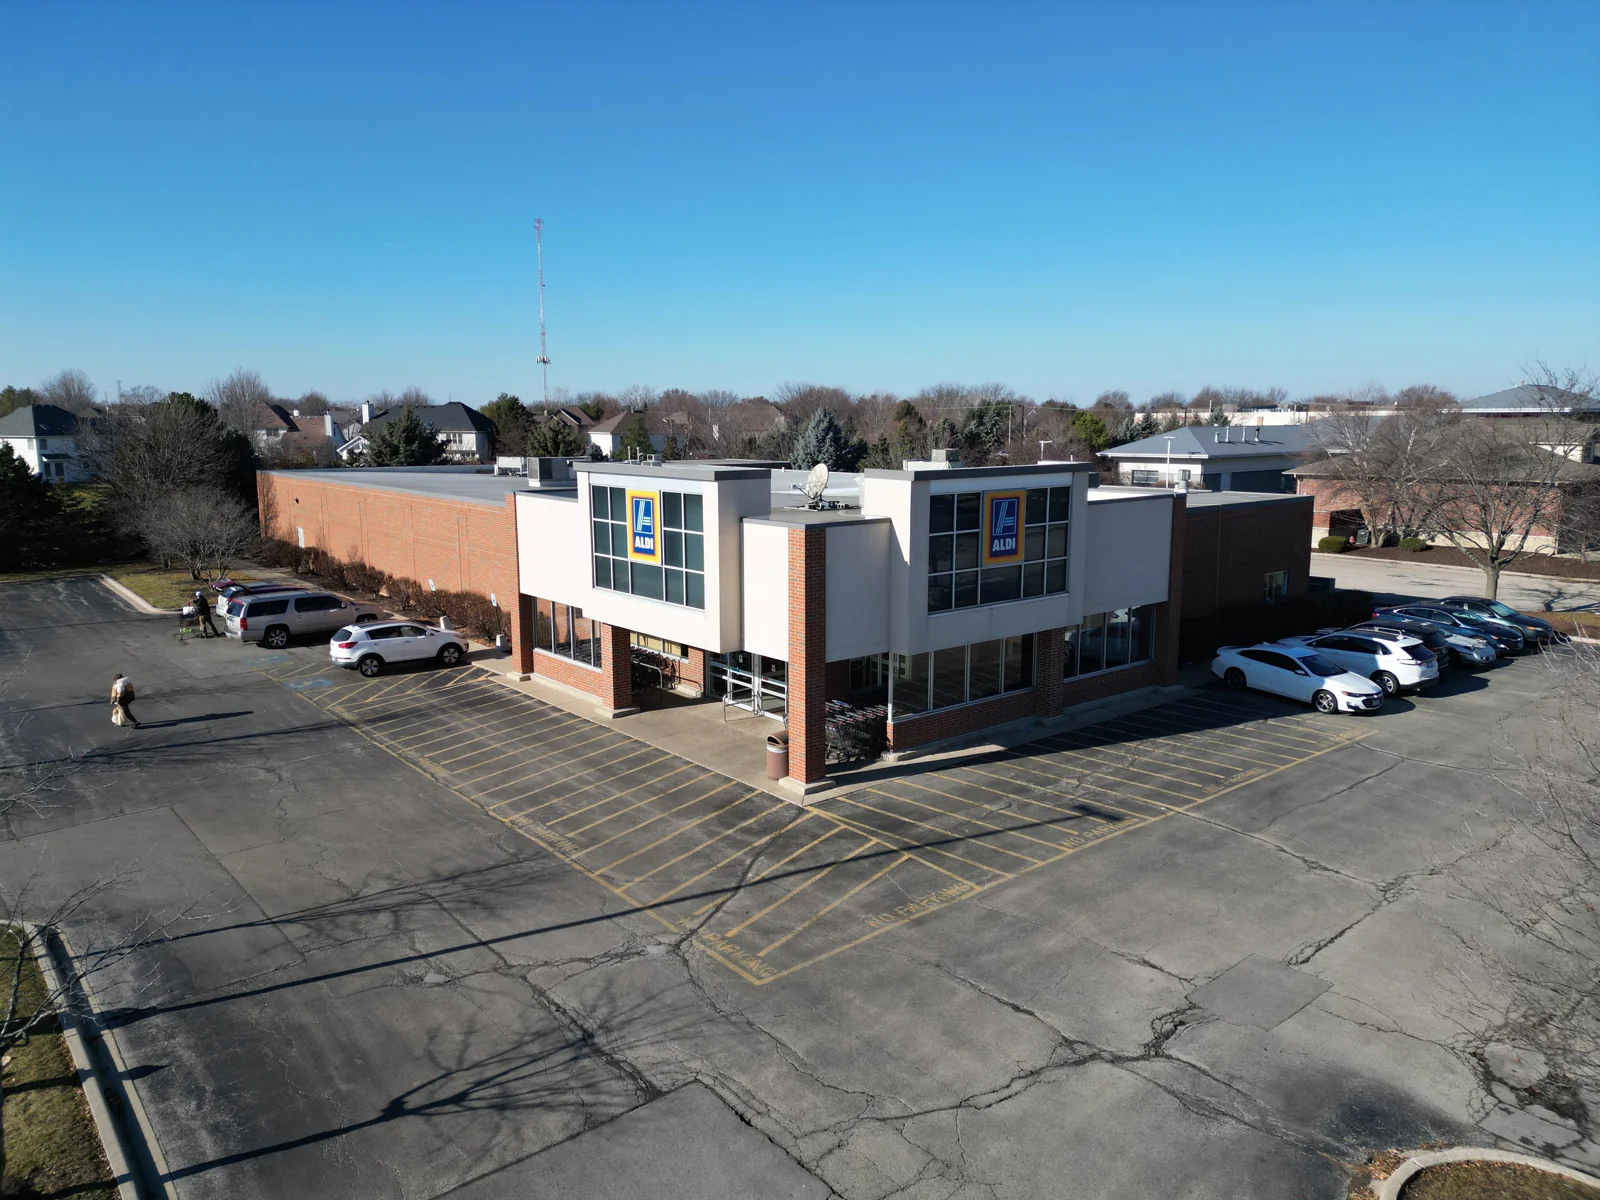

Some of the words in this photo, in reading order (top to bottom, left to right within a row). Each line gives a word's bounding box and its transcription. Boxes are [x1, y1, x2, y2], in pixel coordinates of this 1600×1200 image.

[634, 537, 654, 550] ALDI
[992, 537, 1016, 552] ALDI
[1060, 836, 1085, 848] NO
[864, 913, 896, 928] NO
